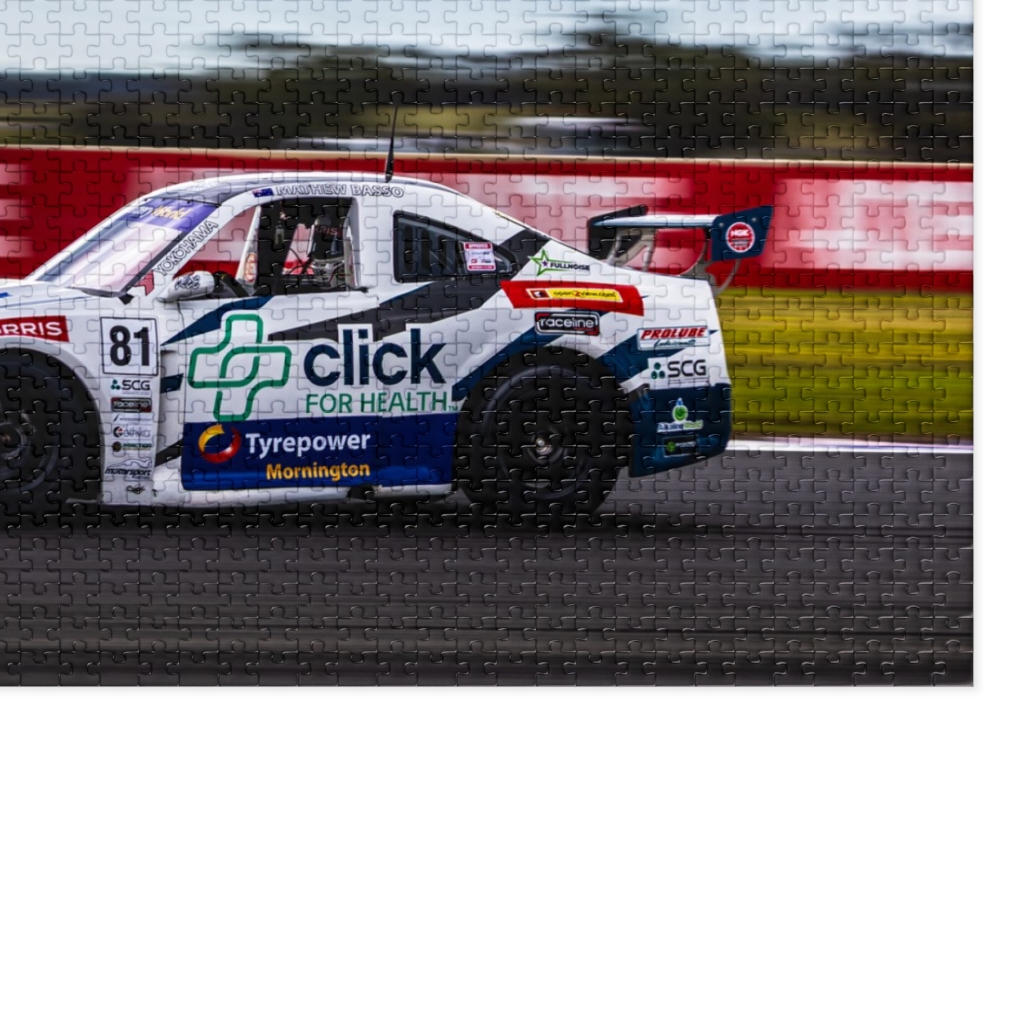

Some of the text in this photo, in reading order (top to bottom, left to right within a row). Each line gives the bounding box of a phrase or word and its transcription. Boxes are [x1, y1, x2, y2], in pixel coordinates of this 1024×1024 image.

[276, 184, 404, 198] MATHEW BASSO
[154, 220, 219, 277] YOKOHAMA
[550, 261, 590, 271] FULLNOISE
[539, 316, 594, 328] raceline
[640, 327, 707, 340] PROLUBE
[109, 325, 150, 367] 81
[304, 328, 447, 387] click
[667, 359, 706, 378] SCG
[122, 380, 150, 391] SCG
[306, 393, 352, 413] FOR
[361, 391, 447, 413] HEALTH
[246, 433, 371, 458] Tyrepower
[104, 468, 151, 478] motorsport
[266, 462, 371, 482] Mornington
